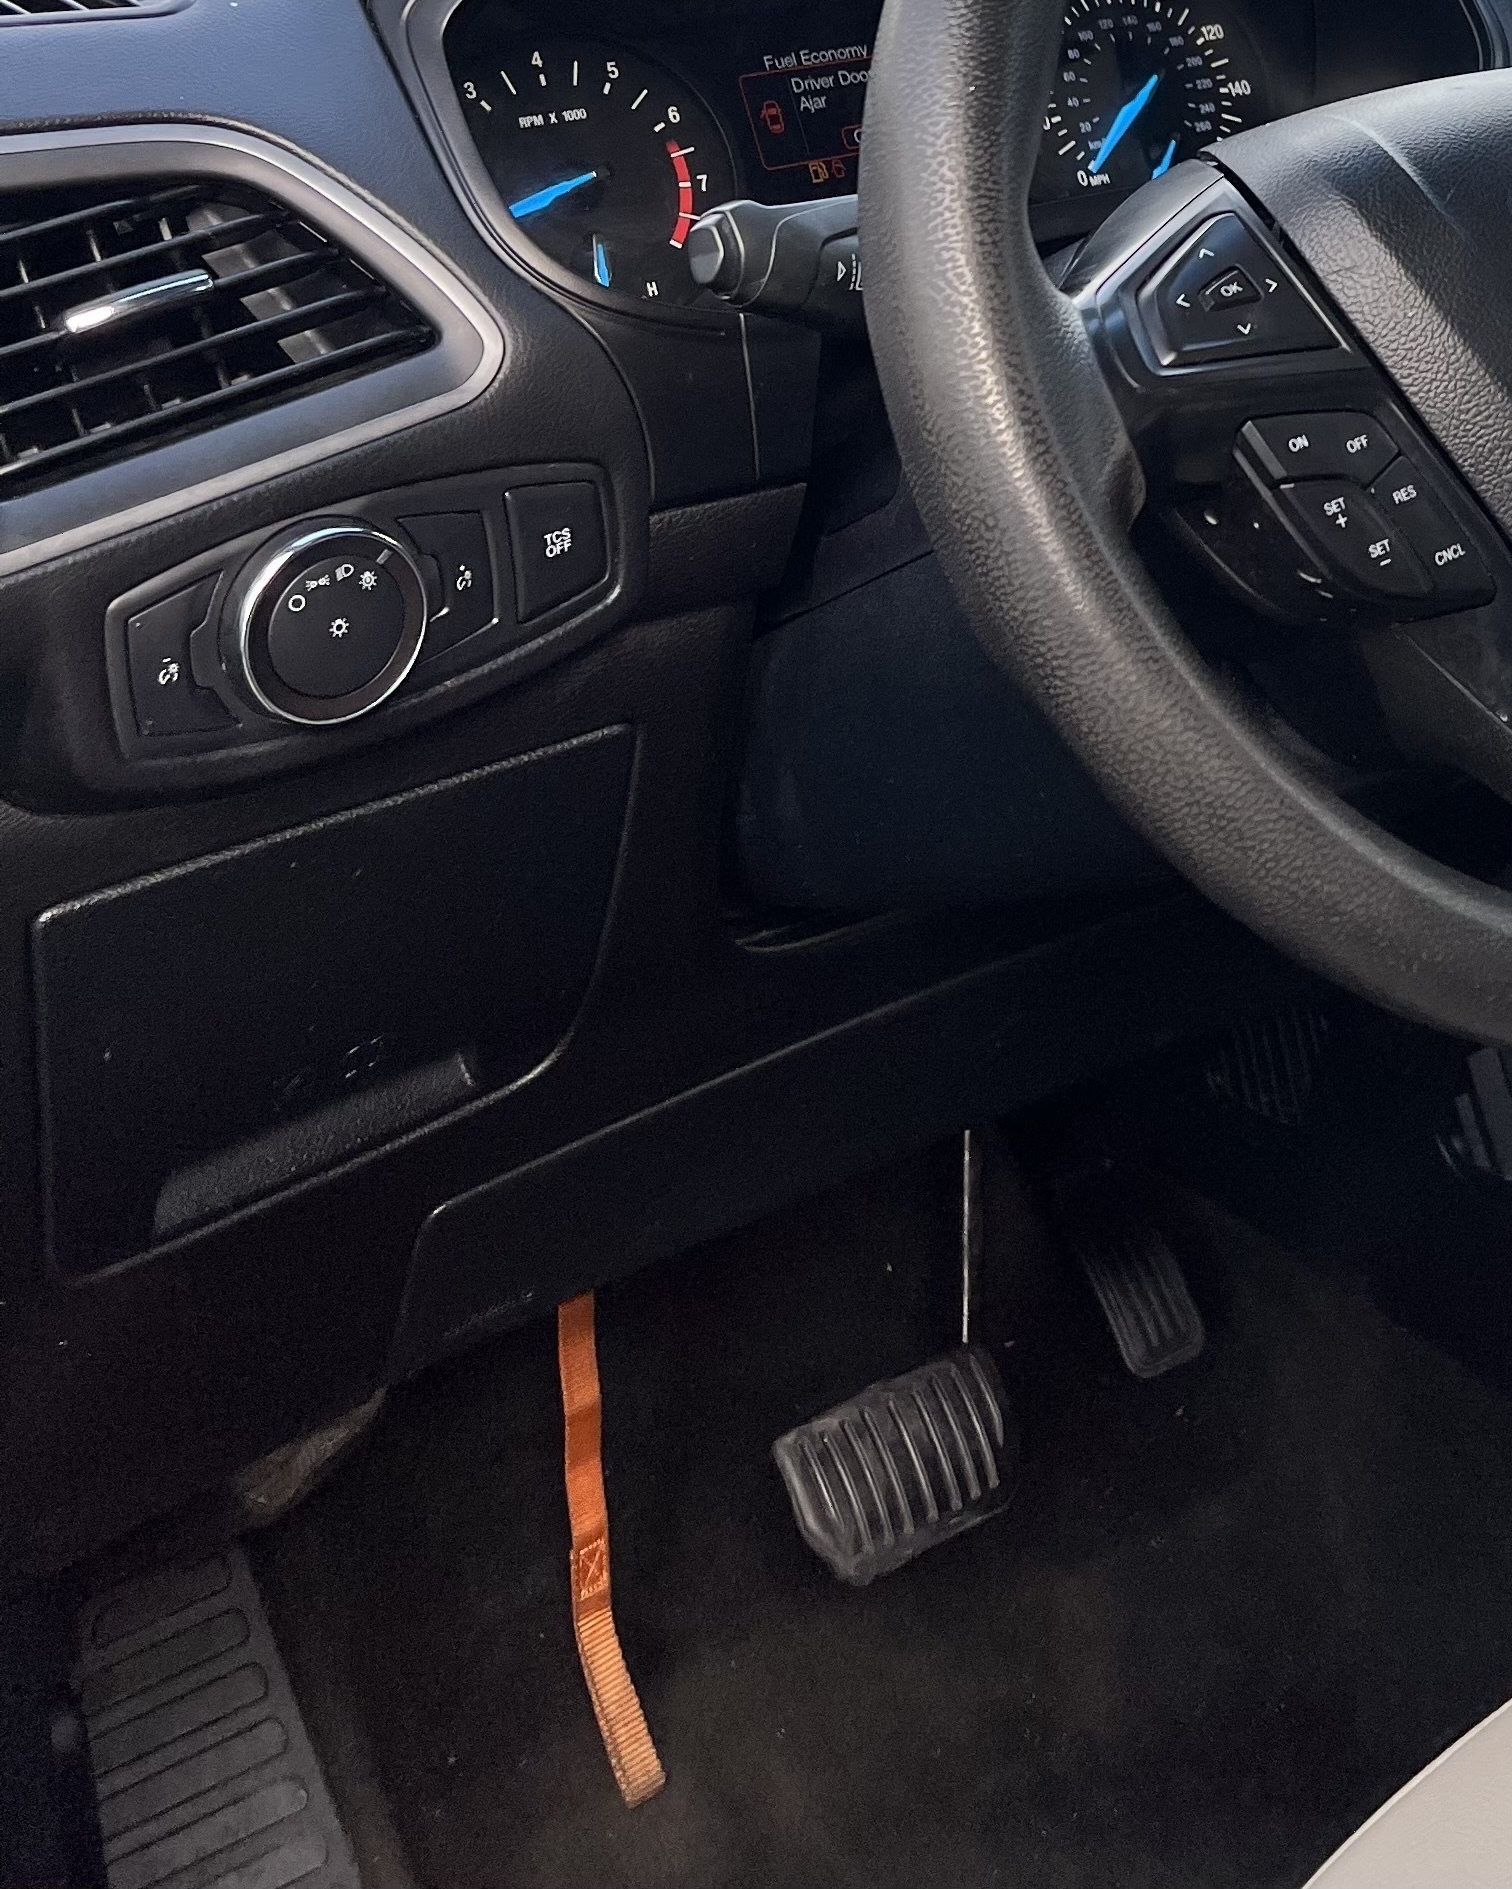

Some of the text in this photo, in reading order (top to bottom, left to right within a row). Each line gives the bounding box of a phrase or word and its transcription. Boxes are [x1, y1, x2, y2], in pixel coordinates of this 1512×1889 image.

[1077, 29, 1095, 42] 100
[1200, 23, 1225, 41] 120
[531, 51, 544, 68] 4
[763, 43, 868, 71] Fuel Economy
[1067, 48, 1081, 60] 80
[1185, 55, 1203, 68] 200
[606, 61, 620, 79] 5
[463, 81, 478, 100] 3
[790, 69, 871, 94] Driver Doo
[1226, 79, 1252, 98] 140
[799, 95, 827, 114] Ajar
[1066, 96, 1080, 108] 40
[518, 107, 588, 130] RPM X 1000
[667, 105, 682, 124] 6
[1079, 121, 1093, 133] 20
[696, 174, 708, 192] 7
[1076, 170, 1111, 187] 0 MPH
[646, 281, 659, 297] H
[1220, 281, 1243, 297] OK
[1288, 434, 1310, 452] ON
[1346, 434, 1369, 454] OFF
[1392, 484, 1417, 504] RES
[1323, 496, 1346, 516] SET
[543, 527, 571, 546] TCS
[545, 538, 572, 558] OFF
[1367, 538, 1391, 558] SET
[1434, 543, 1466, 566] CNCL
